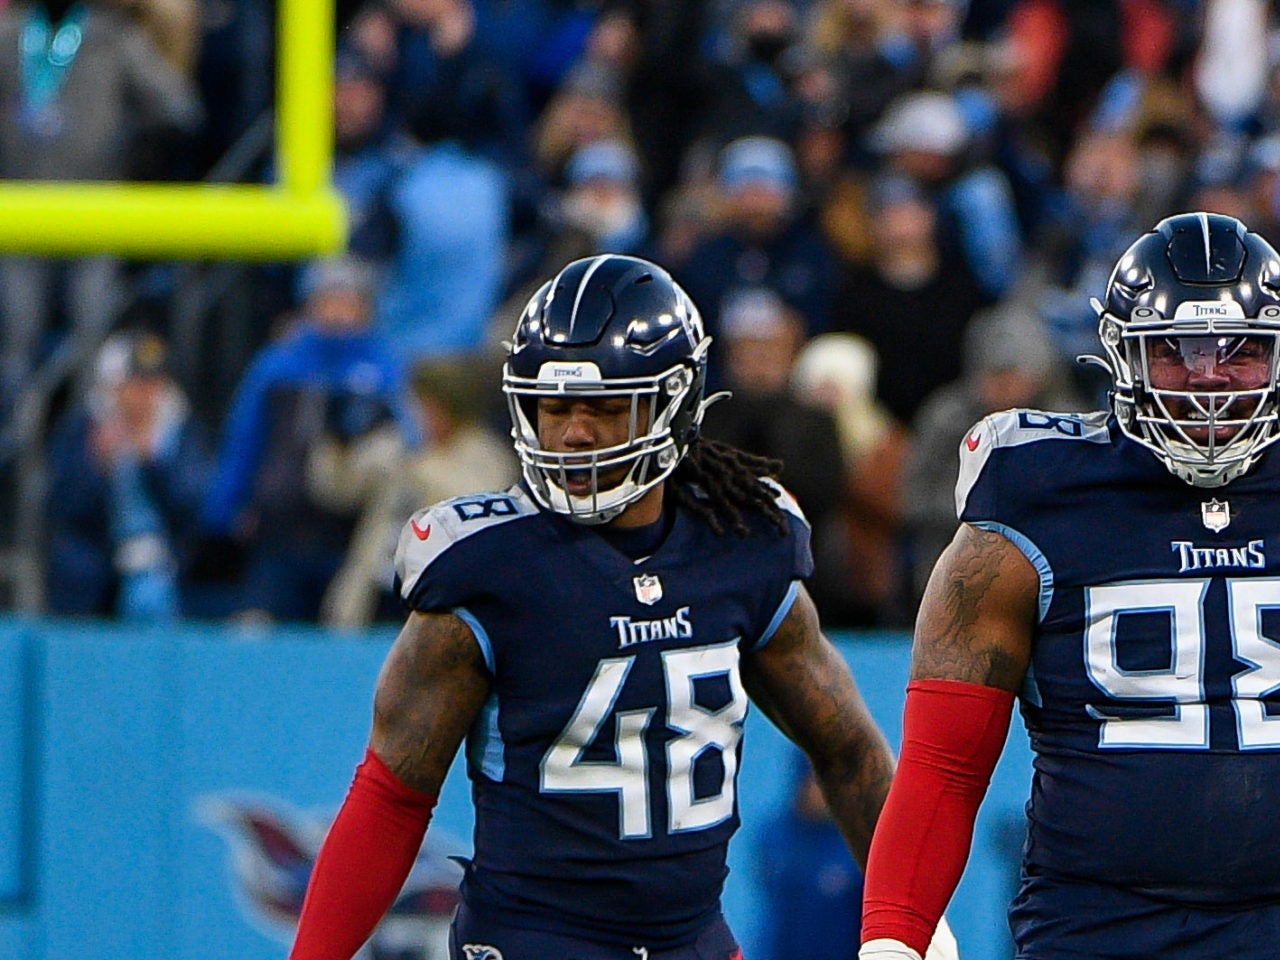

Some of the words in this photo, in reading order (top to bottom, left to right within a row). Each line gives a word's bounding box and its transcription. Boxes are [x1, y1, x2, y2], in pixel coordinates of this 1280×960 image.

[1192, 303, 1227, 317] TITANS
[1171, 539, 1266, 573] TITANS
[609, 606, 693, 649] TITANS
[539, 637, 748, 841] 48
